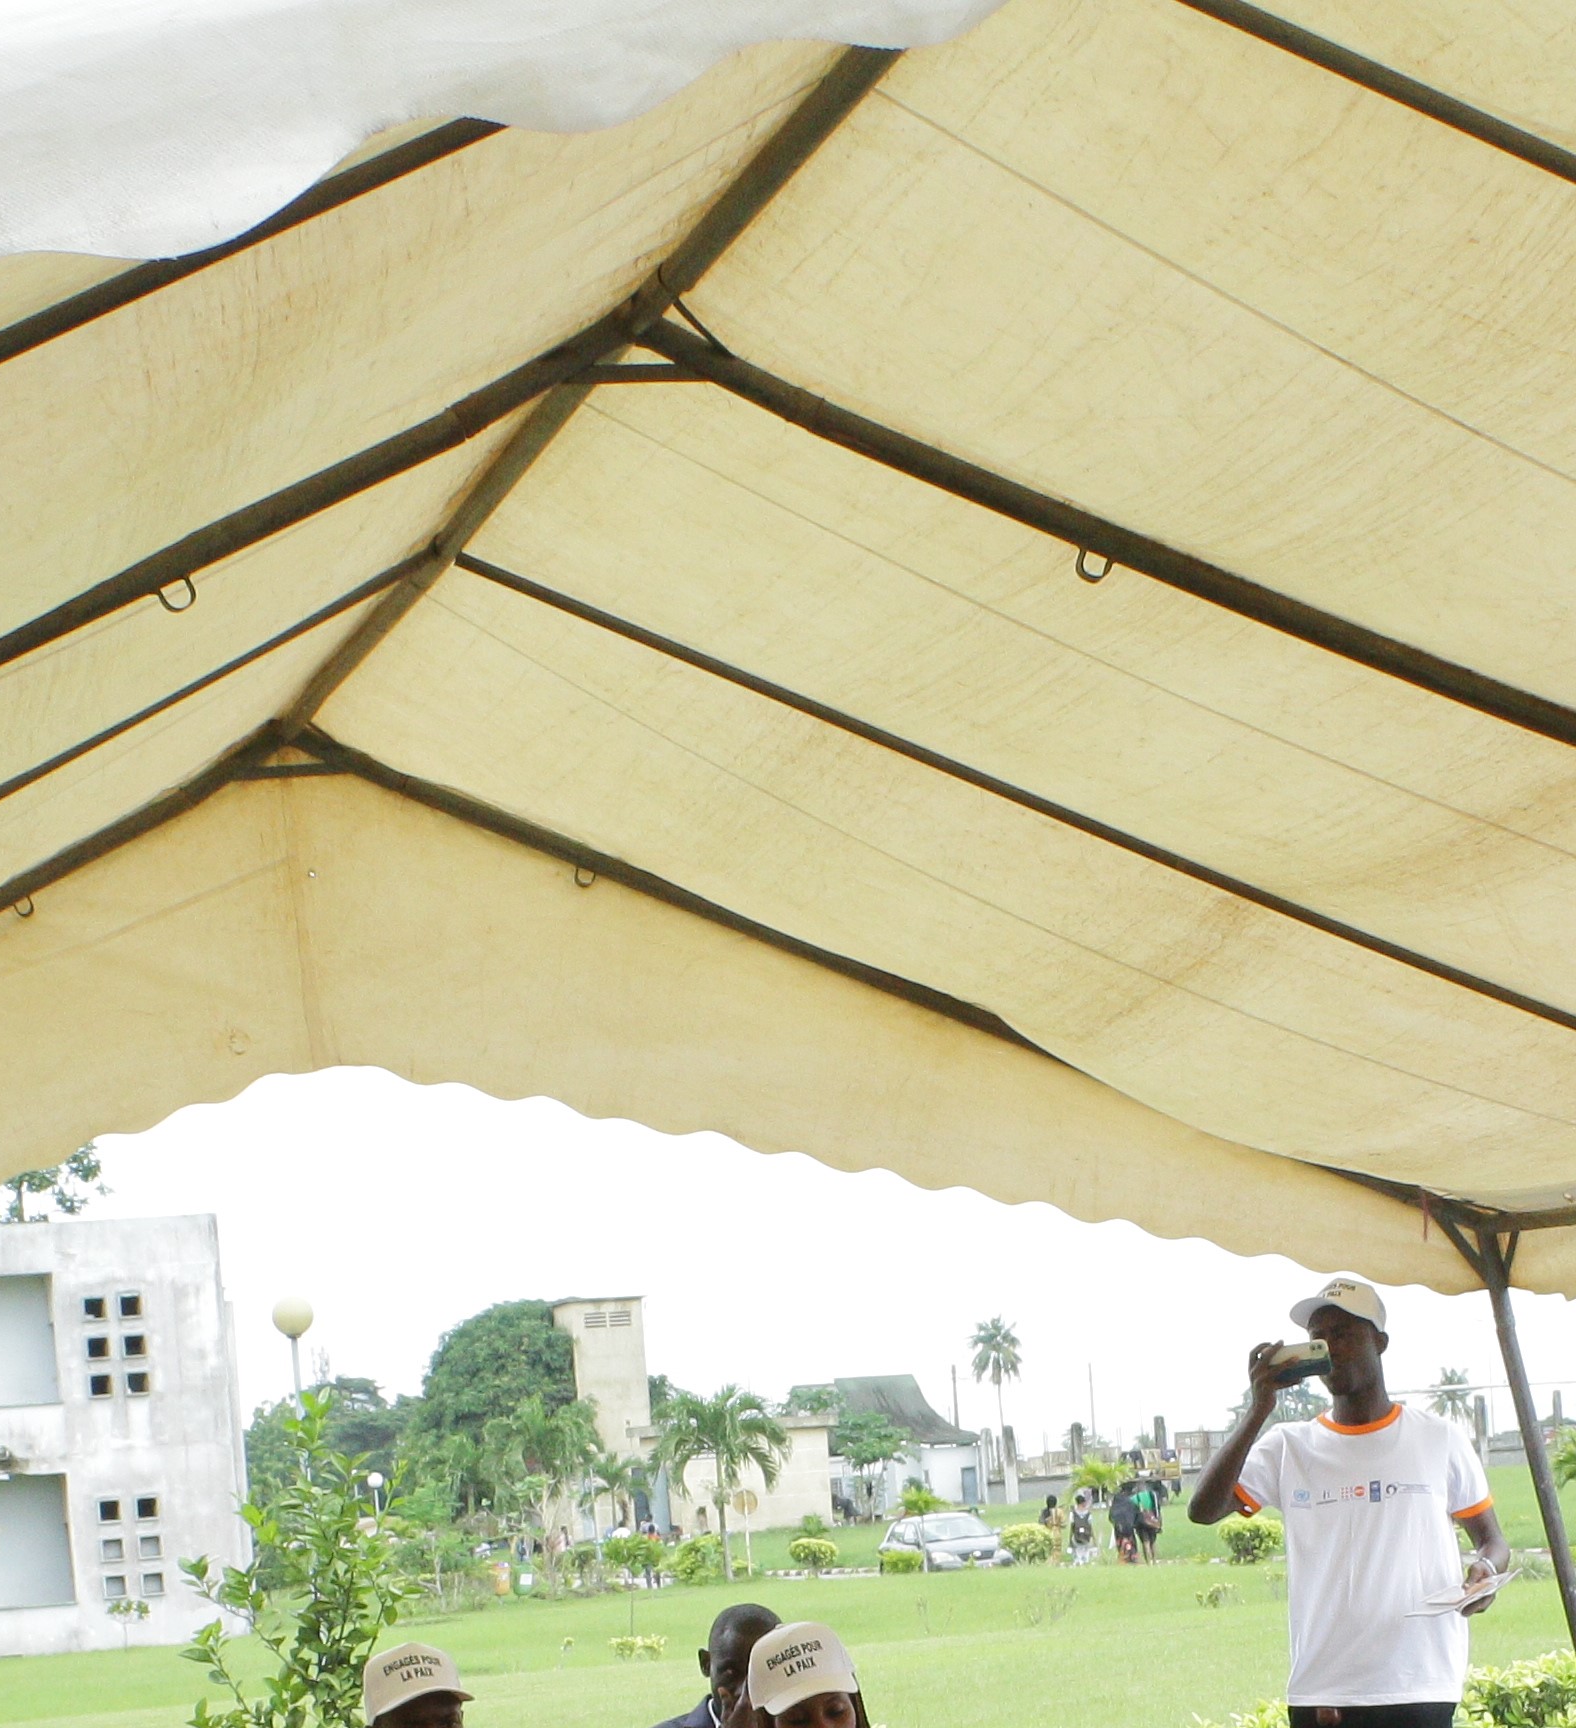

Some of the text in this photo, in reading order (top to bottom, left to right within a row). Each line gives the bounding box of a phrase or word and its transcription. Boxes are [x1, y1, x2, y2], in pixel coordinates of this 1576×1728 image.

[383, 1654, 442, 1676] ENGAGÉS POUR
[766, 1640, 823, 1671] ENGAGÉS POUR
[400, 1667, 434, 1682] LA PAIX
[784, 1656, 816, 1677] LA PAIX
